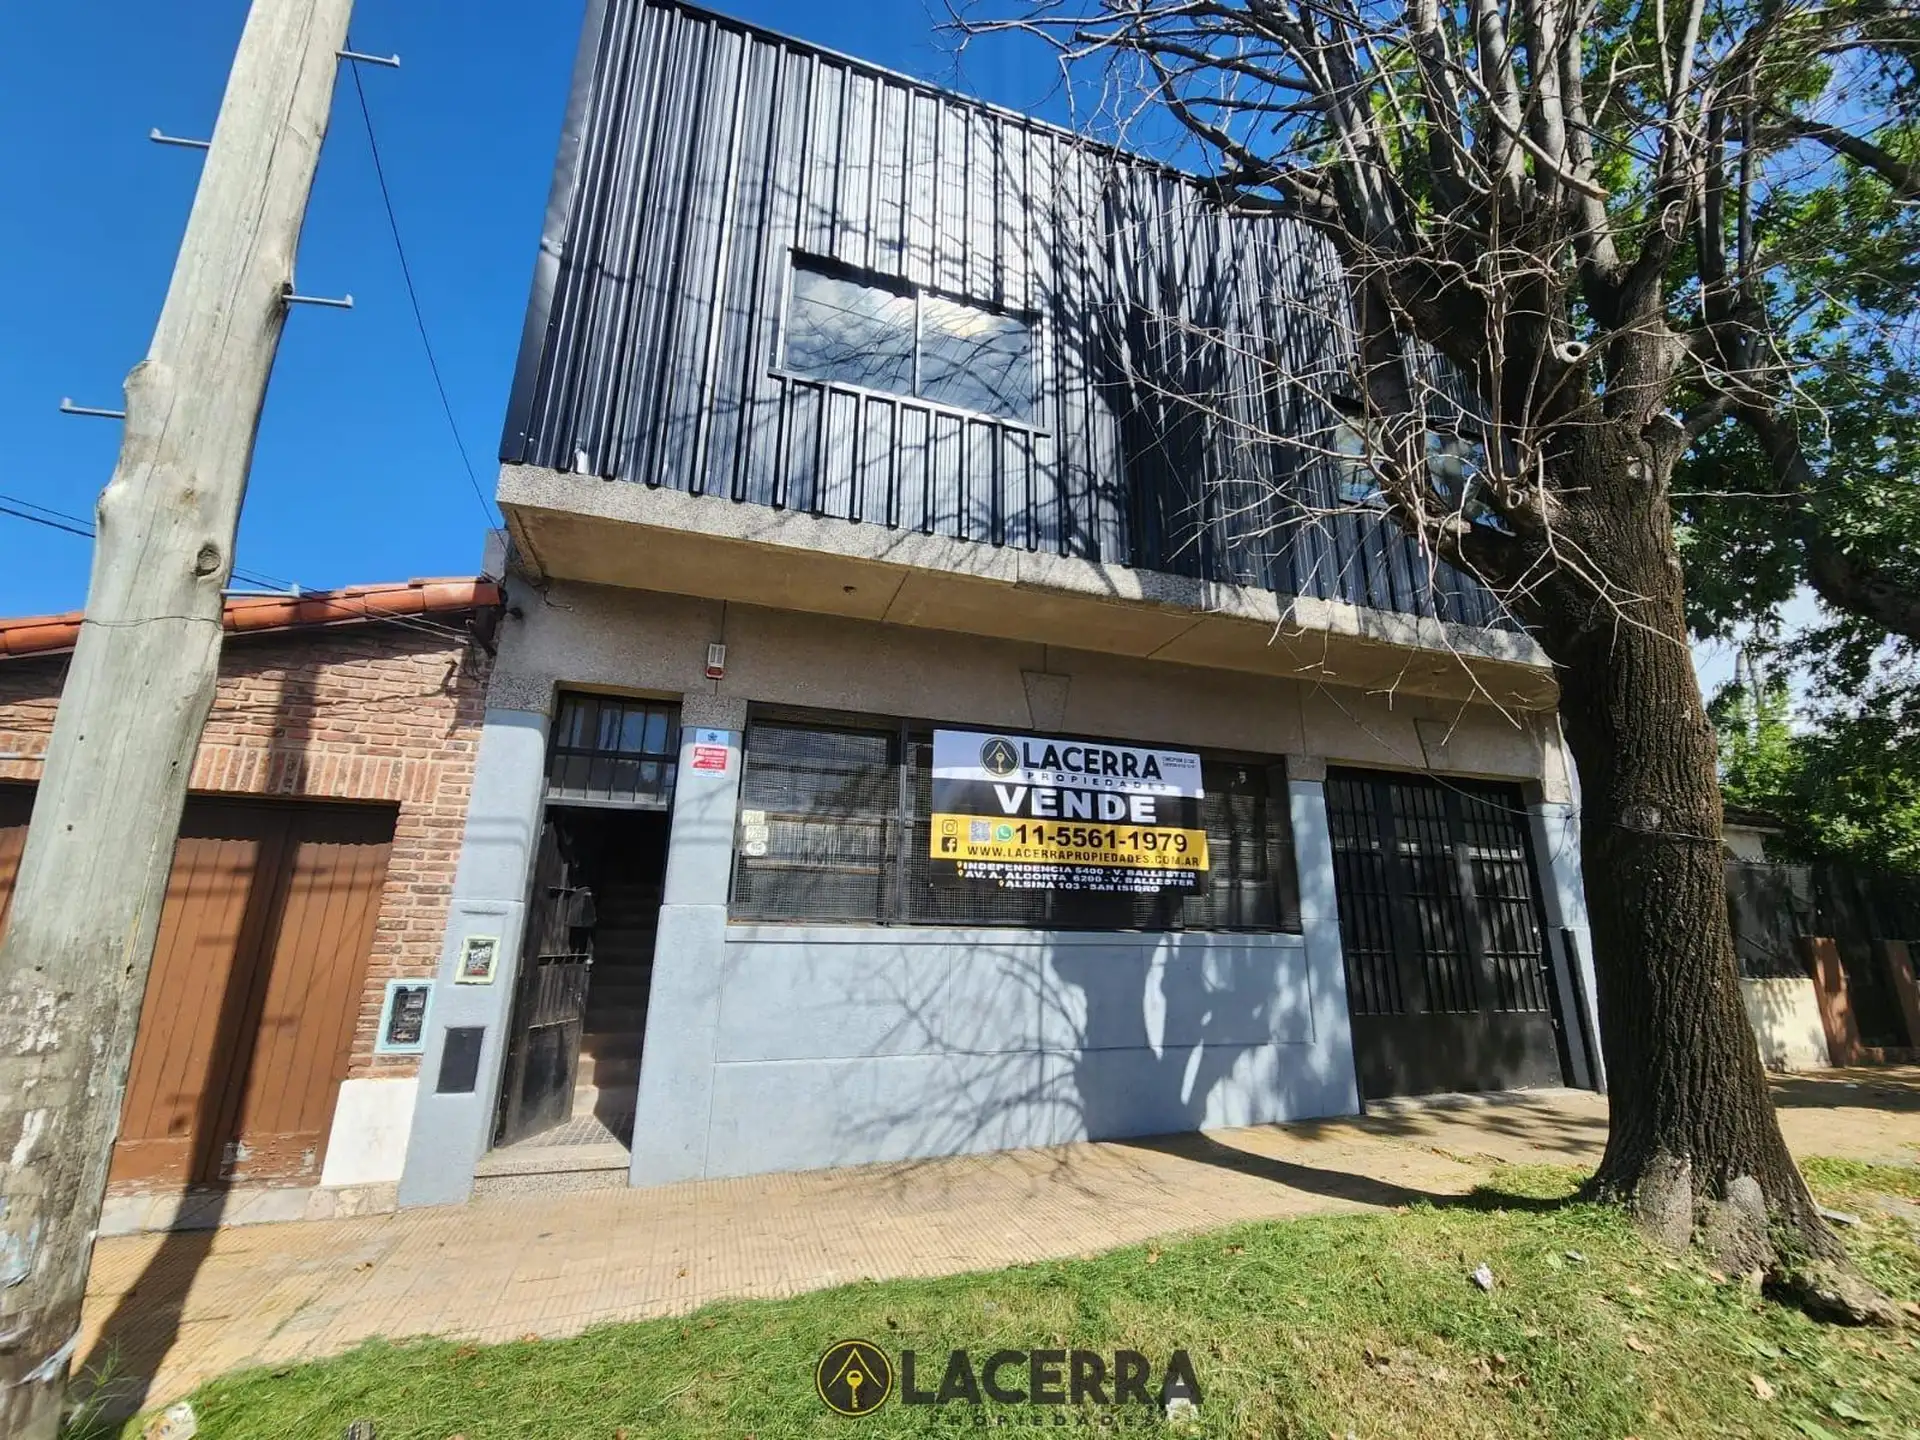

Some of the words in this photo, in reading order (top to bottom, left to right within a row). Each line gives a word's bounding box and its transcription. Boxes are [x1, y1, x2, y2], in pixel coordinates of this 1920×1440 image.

[1023, 742, 1162, 780] LACERRA
[1027, 771, 1166, 791] PROPIEDADES
[994, 784, 1157, 823] VENDE
[1016, 823, 1188, 853] 11-5561-1979
[967, 845, 1200, 866] WWW.LACERRAPROPIEDADES.COM.AR
[963, 862, 1072, 873] INDEPENDENCIA
[1126, 869, 1196, 879] BALLESTER
[965, 870, 986, 879] AV.
[988, 871, 1003, 879] A.
[1005, 871, 1067, 881] ALCORTA
[1124, 877, 1194, 887] BALLESTER
[1005, 880, 1055, 889] ALSINA
[1058, 882, 1080, 890] 103
[1117, 884, 1160, 893] ISIDRO
